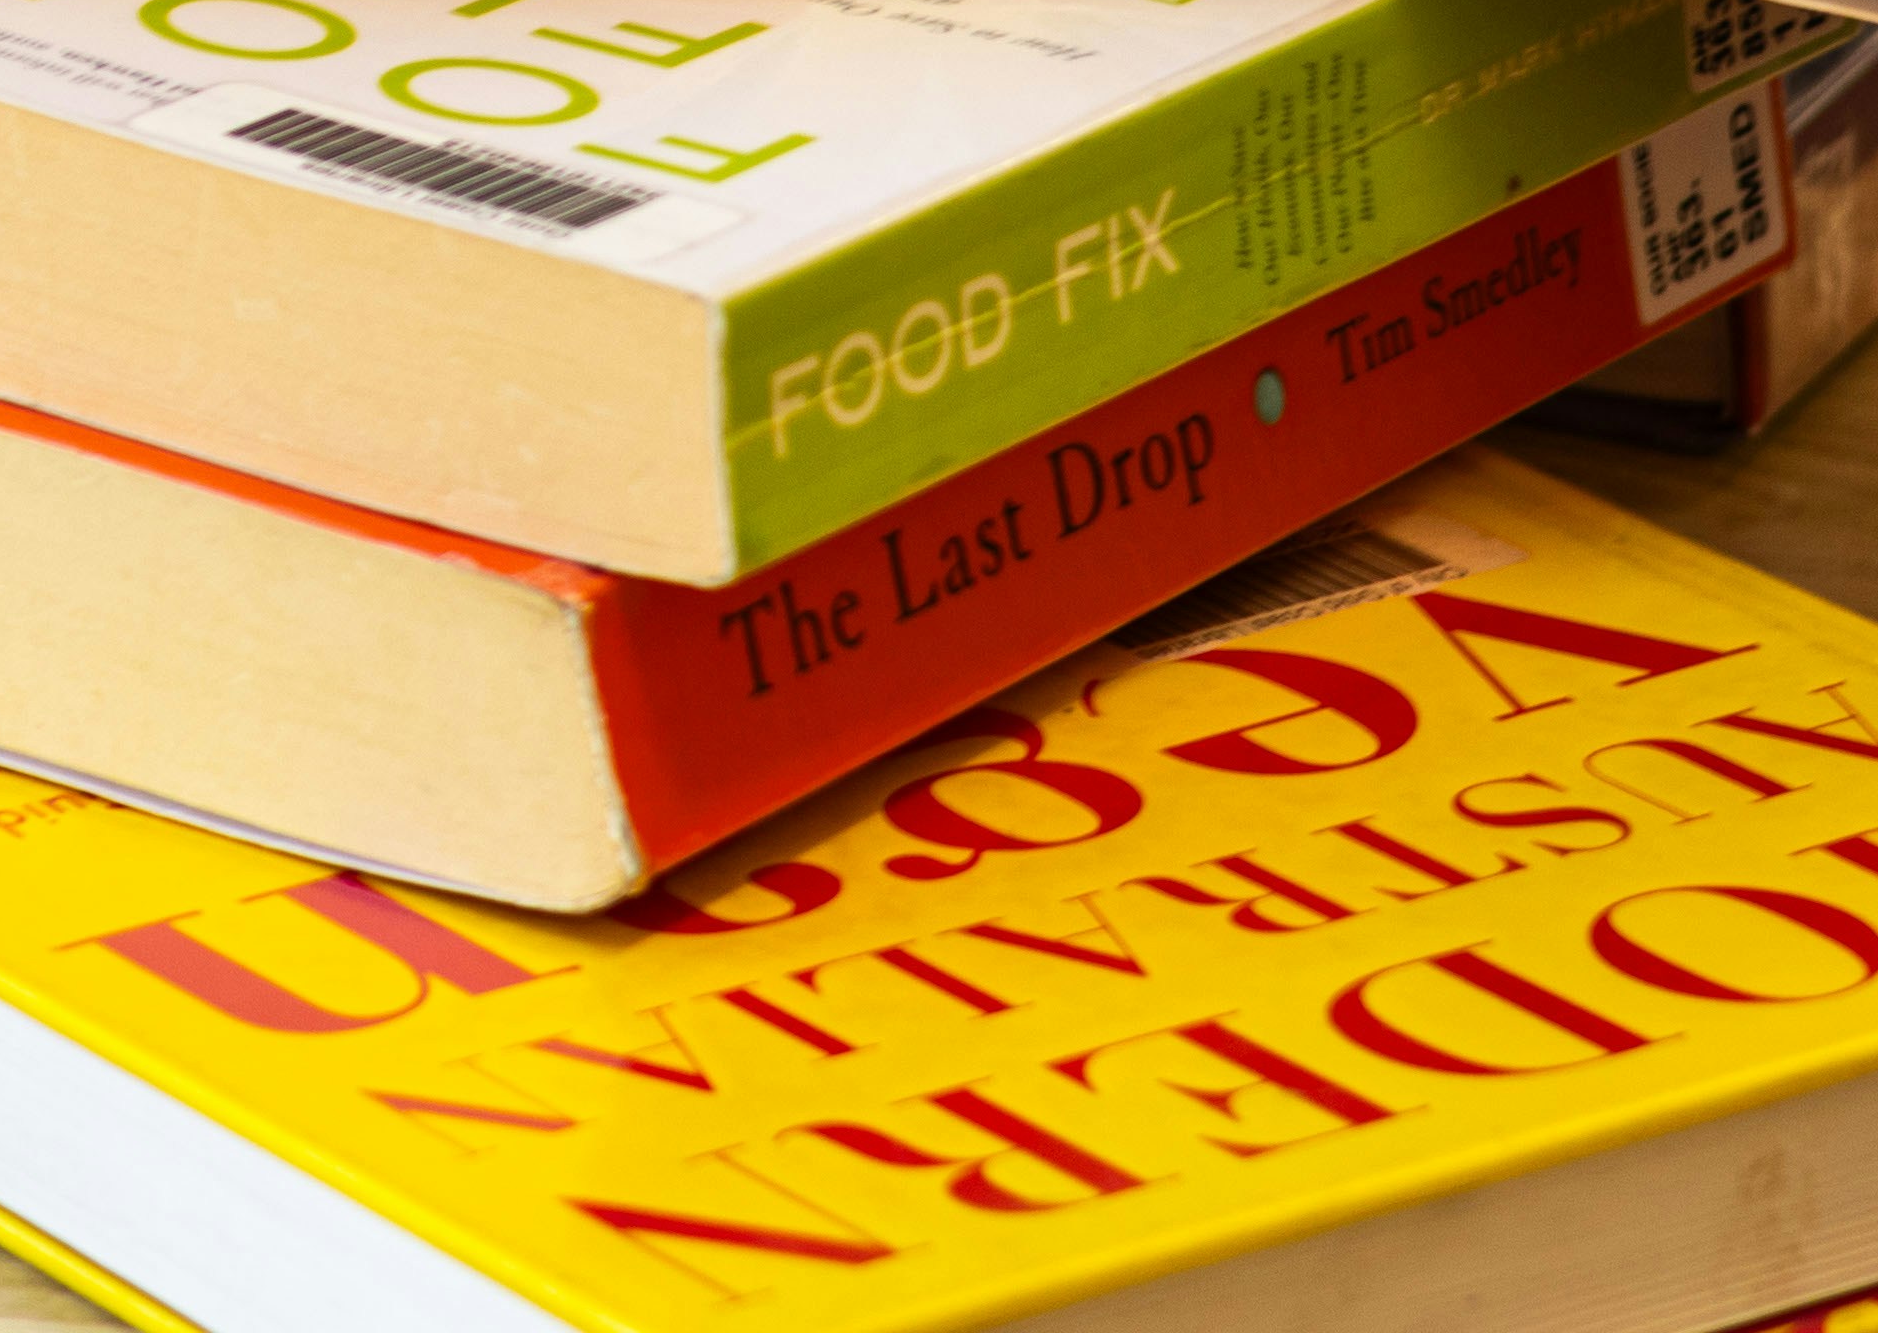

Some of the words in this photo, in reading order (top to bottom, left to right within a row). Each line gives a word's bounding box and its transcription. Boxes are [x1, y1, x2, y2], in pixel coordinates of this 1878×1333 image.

[1324, 310, 1415, 385] Tim
[1421, 222, 1585, 339] Smedley
[1729, 101, 1770, 247] SMED
[771, 273, 1011, 460] FOOD
[1054, 187, 1178, 324] FIX
[719, 580, 866, 700] The
[880, 498, 1033, 624] Last
[1046, 411, 1216, 540] Drop
[561, 829, 1878, 1302] ODERN
